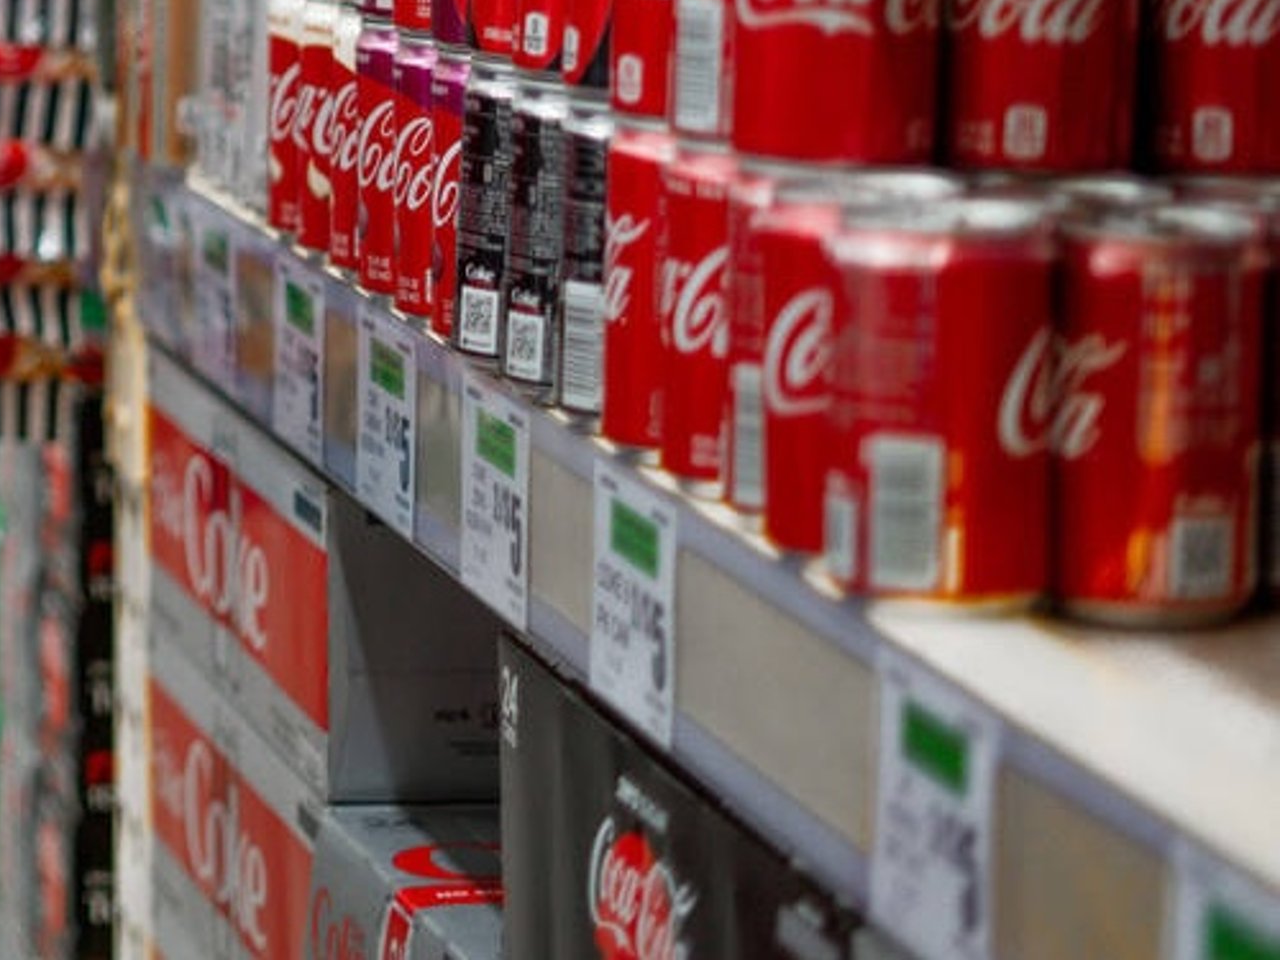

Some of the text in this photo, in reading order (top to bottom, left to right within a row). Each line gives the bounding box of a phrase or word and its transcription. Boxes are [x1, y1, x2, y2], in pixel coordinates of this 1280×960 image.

[183, 453, 268, 650] Coke
[500, 664, 520, 724] 24
[183, 738, 268, 953] Coke
